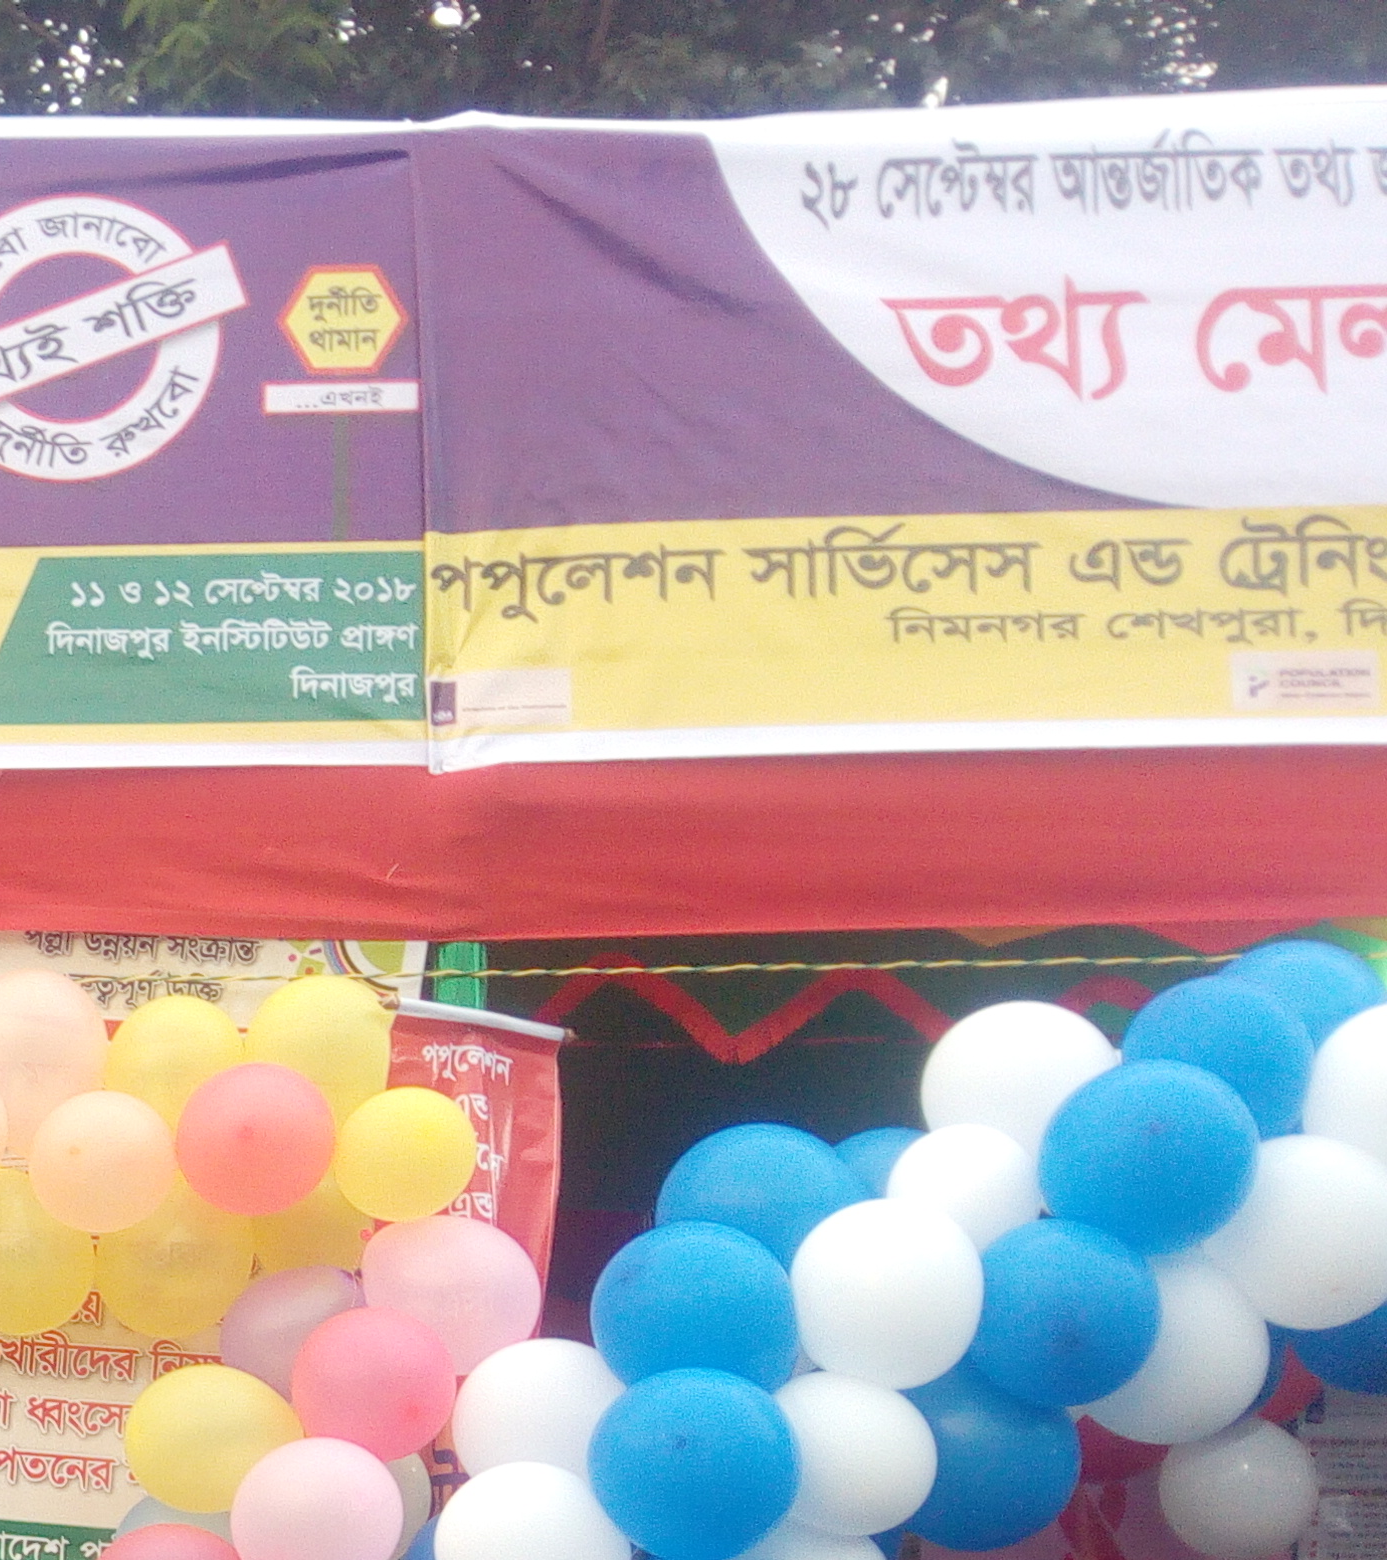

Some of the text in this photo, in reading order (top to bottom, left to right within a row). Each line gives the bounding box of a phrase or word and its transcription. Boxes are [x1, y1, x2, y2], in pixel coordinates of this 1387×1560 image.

[800, 157, 859, 228] ২৮
[876, 138, 1041, 219] সেপ্টেম্বর
[1050, 128, 1267, 212] আন্তর্জাতিক
[1273, 141, 1357, 207] তথ্য
[82, 277, 198, 339] শক্তি
[307, 286, 382, 322] দুর্নীতি
[309, 327, 380, 352] থামান
[879, 273, 1150, 401] তথ্য
[70, 571, 417, 608] ১১ ও ১২ সেপ্টেম্বর ২০১৮
[430, 543, 726, 623] পপুলেশন
[742, 523, 1042, 594] সার্ভিসেস
[1069, 537, 1192, 592] এন্ড
[46, 620, 172, 660] দিনাজপুর
[340, 620, 417, 653] প্রাঙ্গণ
[884, 606, 1085, 643] নিমনগর
[290, 665, 418, 704] দিনাজপুর
[167, 936, 263, 965] সংক্রান্ত
[421, 1042, 513, 1086] পপুলেশন
